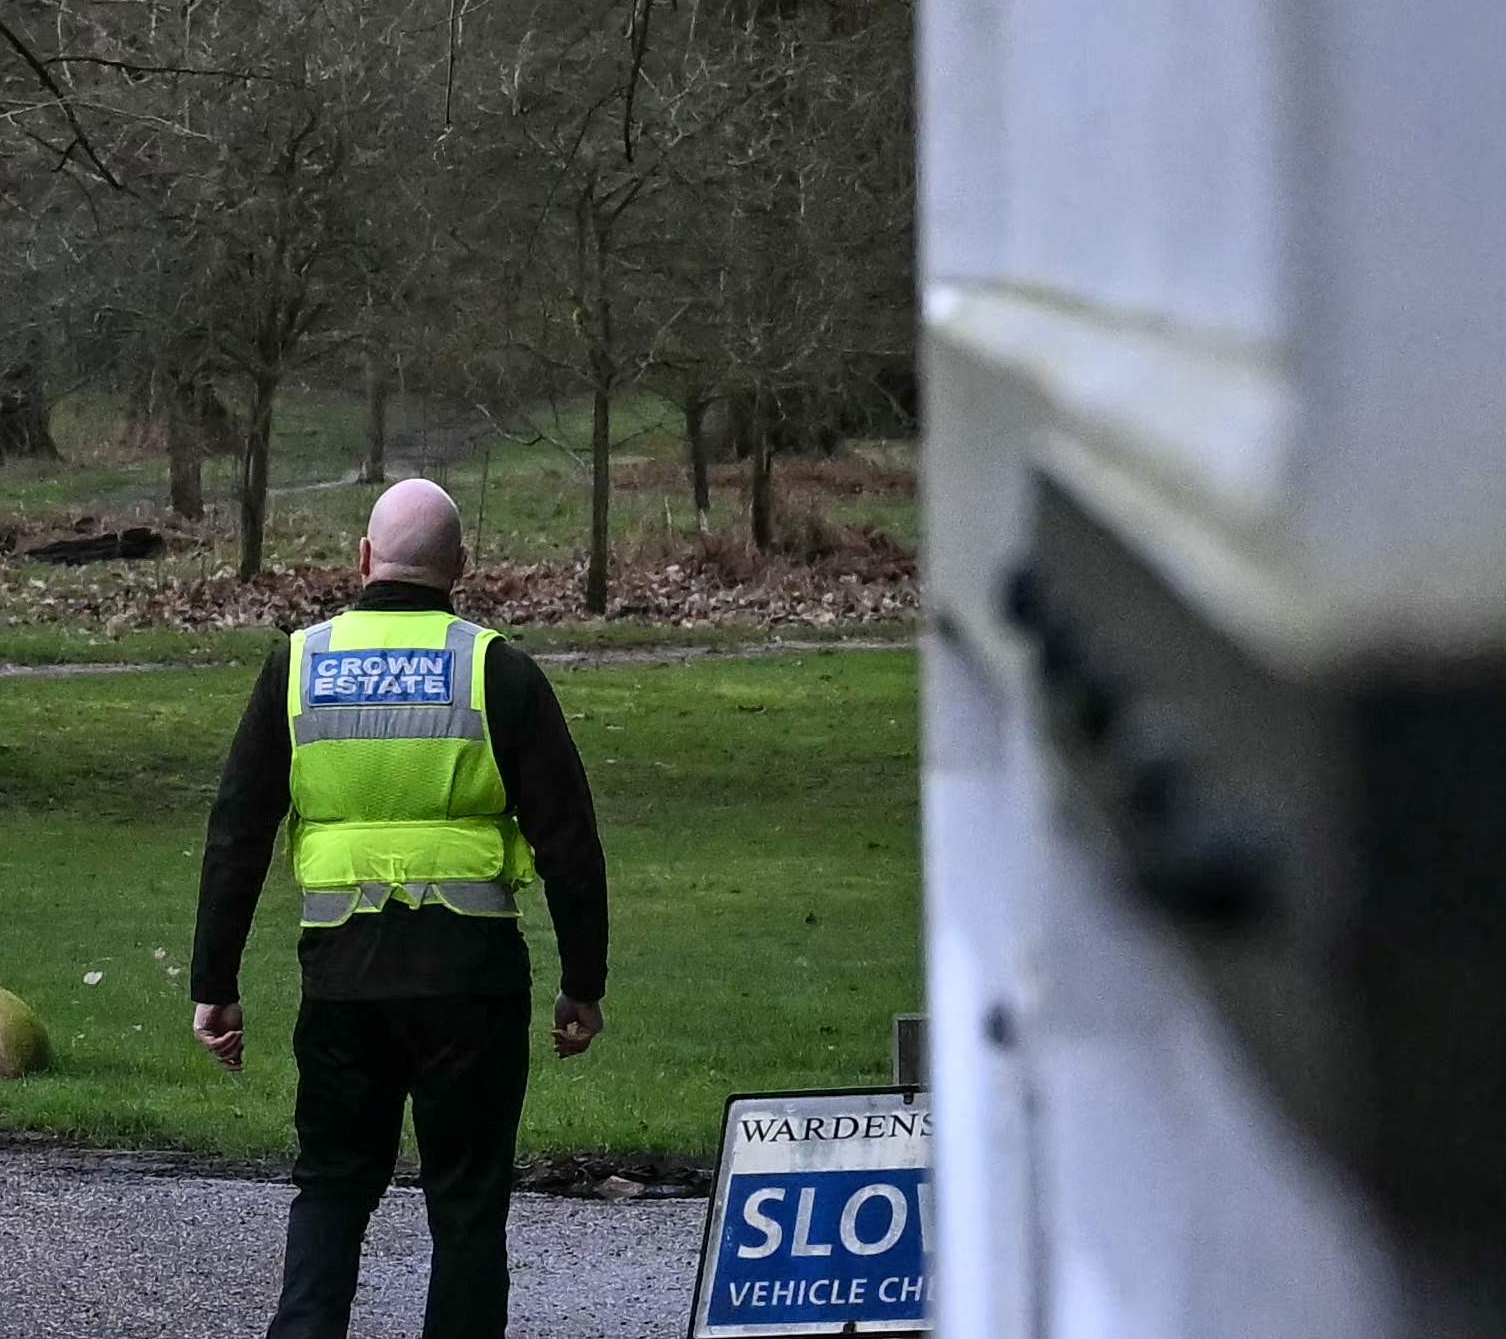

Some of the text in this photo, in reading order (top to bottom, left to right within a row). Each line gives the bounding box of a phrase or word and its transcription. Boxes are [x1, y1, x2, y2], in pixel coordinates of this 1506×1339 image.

[317, 656, 444, 677] CROWN
[314, 675, 446, 696] ESTATE
[729, 1277, 868, 1307] VEHICLE
